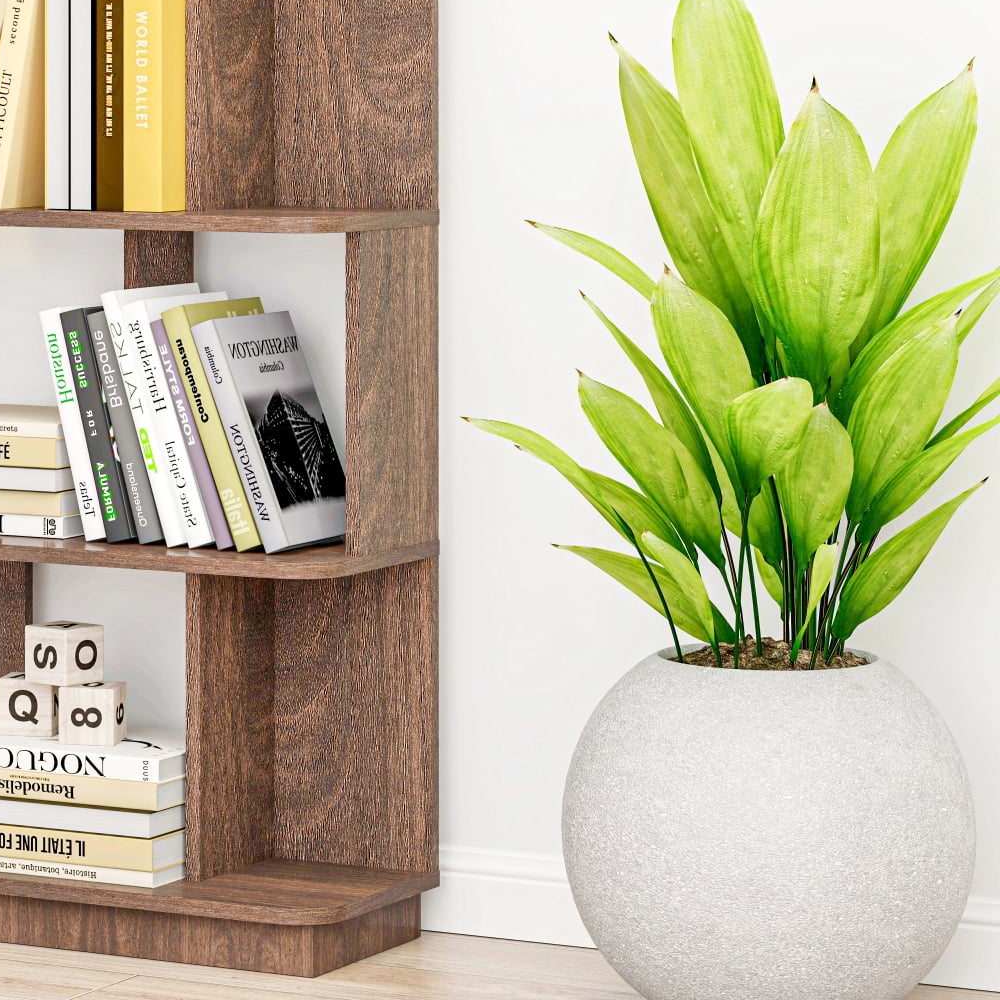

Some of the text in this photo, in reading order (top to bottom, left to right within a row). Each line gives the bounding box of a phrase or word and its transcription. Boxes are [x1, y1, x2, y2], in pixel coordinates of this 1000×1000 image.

[9, 6, 21, 45] second
[135, 10, 148, 129] WORLD BALLET
[8, 689, 39, 725] Q
[70, 707, 102, 729] 8
[15, 834, 38, 852] UNE
[41, 837, 73, 859] ÉTAIT
[76, 840, 86, 857] IL
[0, 860, 17, 869] arts
[18, 862, 60, 875] botanique,
[62, 866, 97, 879] Histoire,
